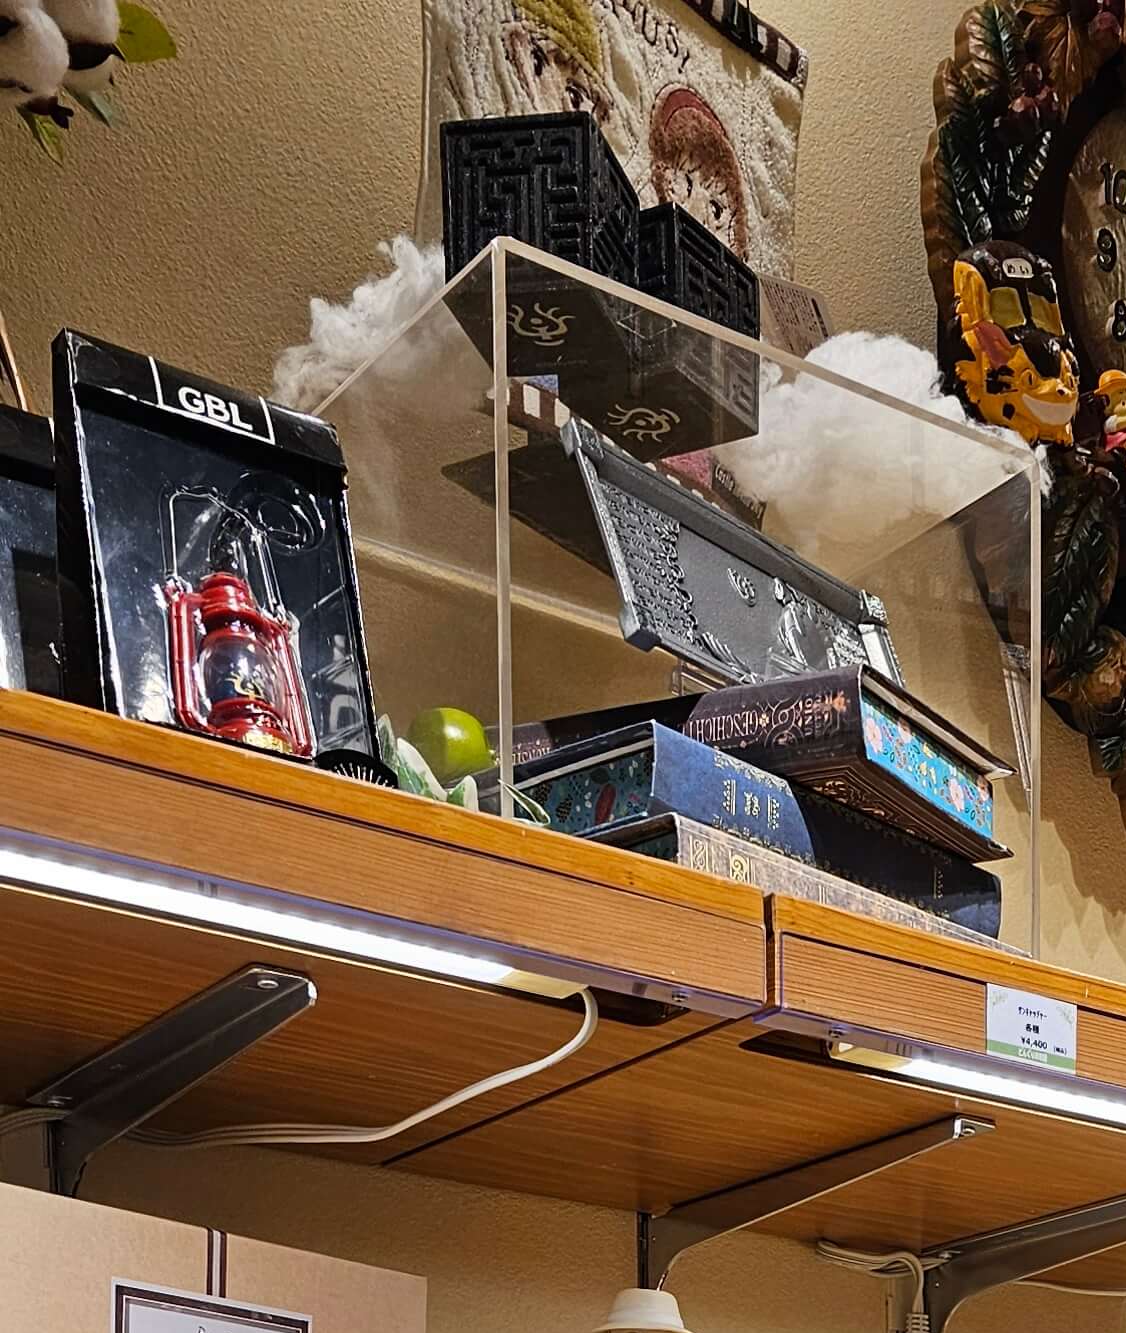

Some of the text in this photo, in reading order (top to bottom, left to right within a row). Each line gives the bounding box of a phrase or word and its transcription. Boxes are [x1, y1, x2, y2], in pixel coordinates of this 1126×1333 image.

[1096, 228, 1117, 273] 9
[178, 386, 253, 431] GBL
[1021, 1036, 1048, 1050] ¥4,400
